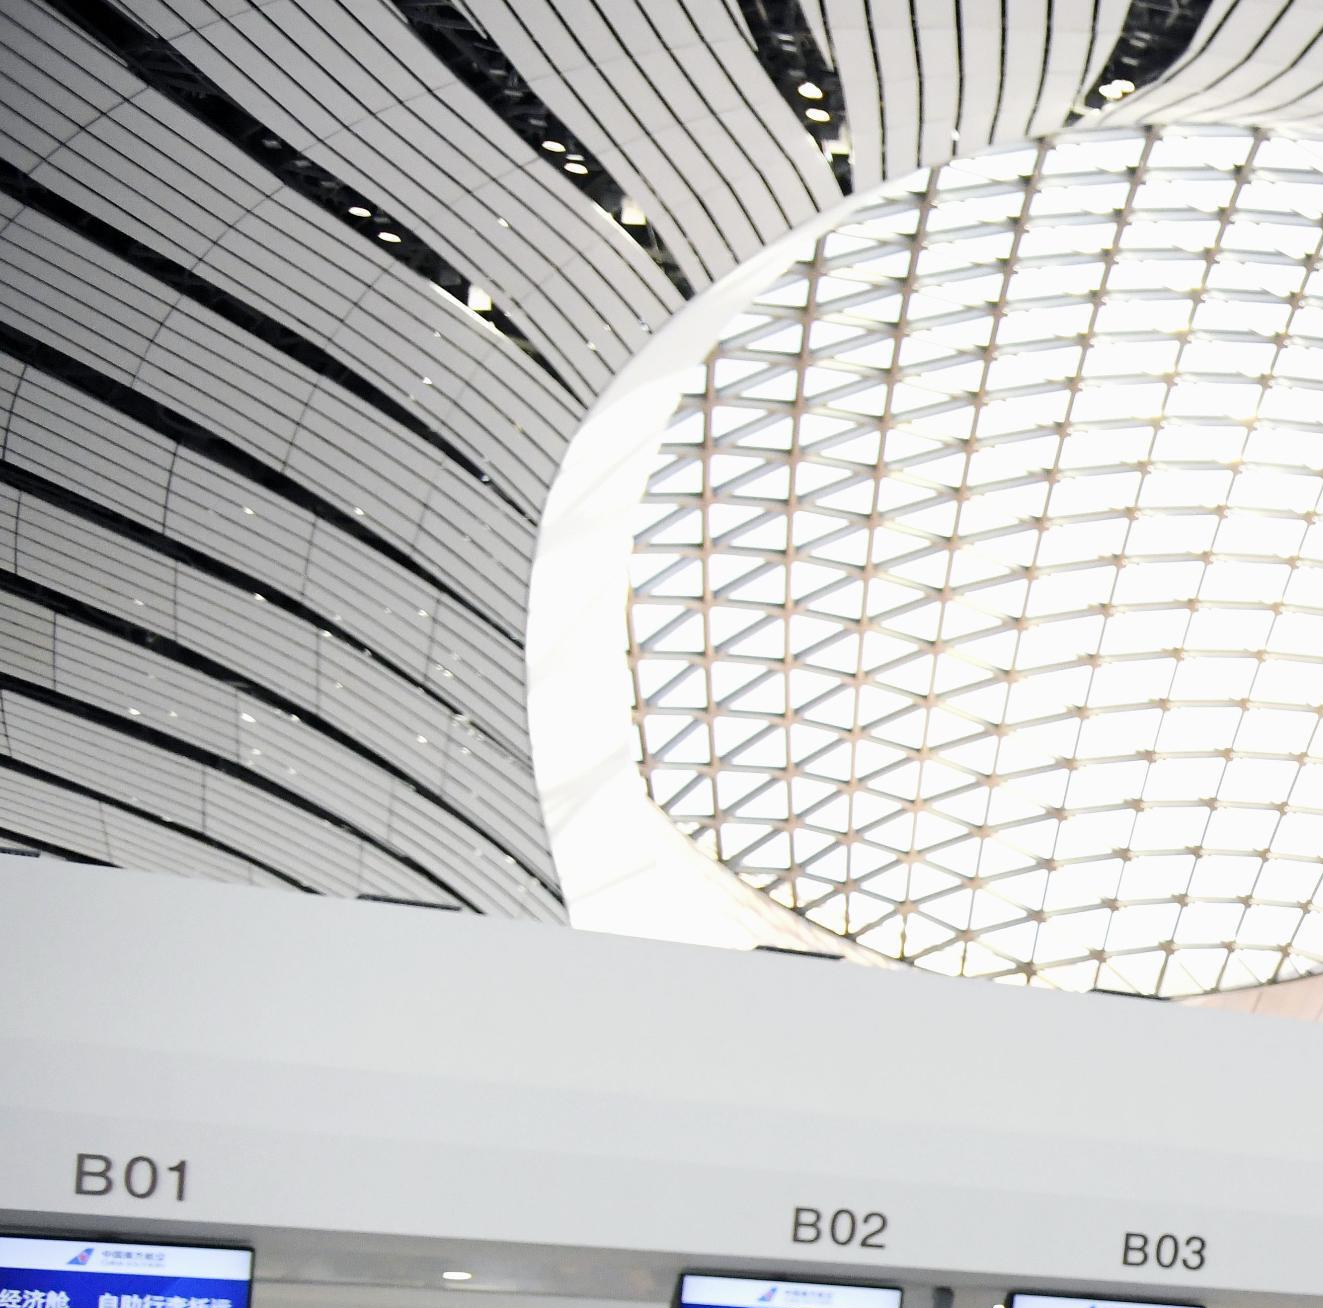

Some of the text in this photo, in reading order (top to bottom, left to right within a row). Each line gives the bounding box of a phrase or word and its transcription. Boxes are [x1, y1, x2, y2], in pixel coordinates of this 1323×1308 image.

[75, 1153, 189, 1202] B01
[793, 1208, 888, 1248] B02
[1123, 1232, 1206, 1270] B03
